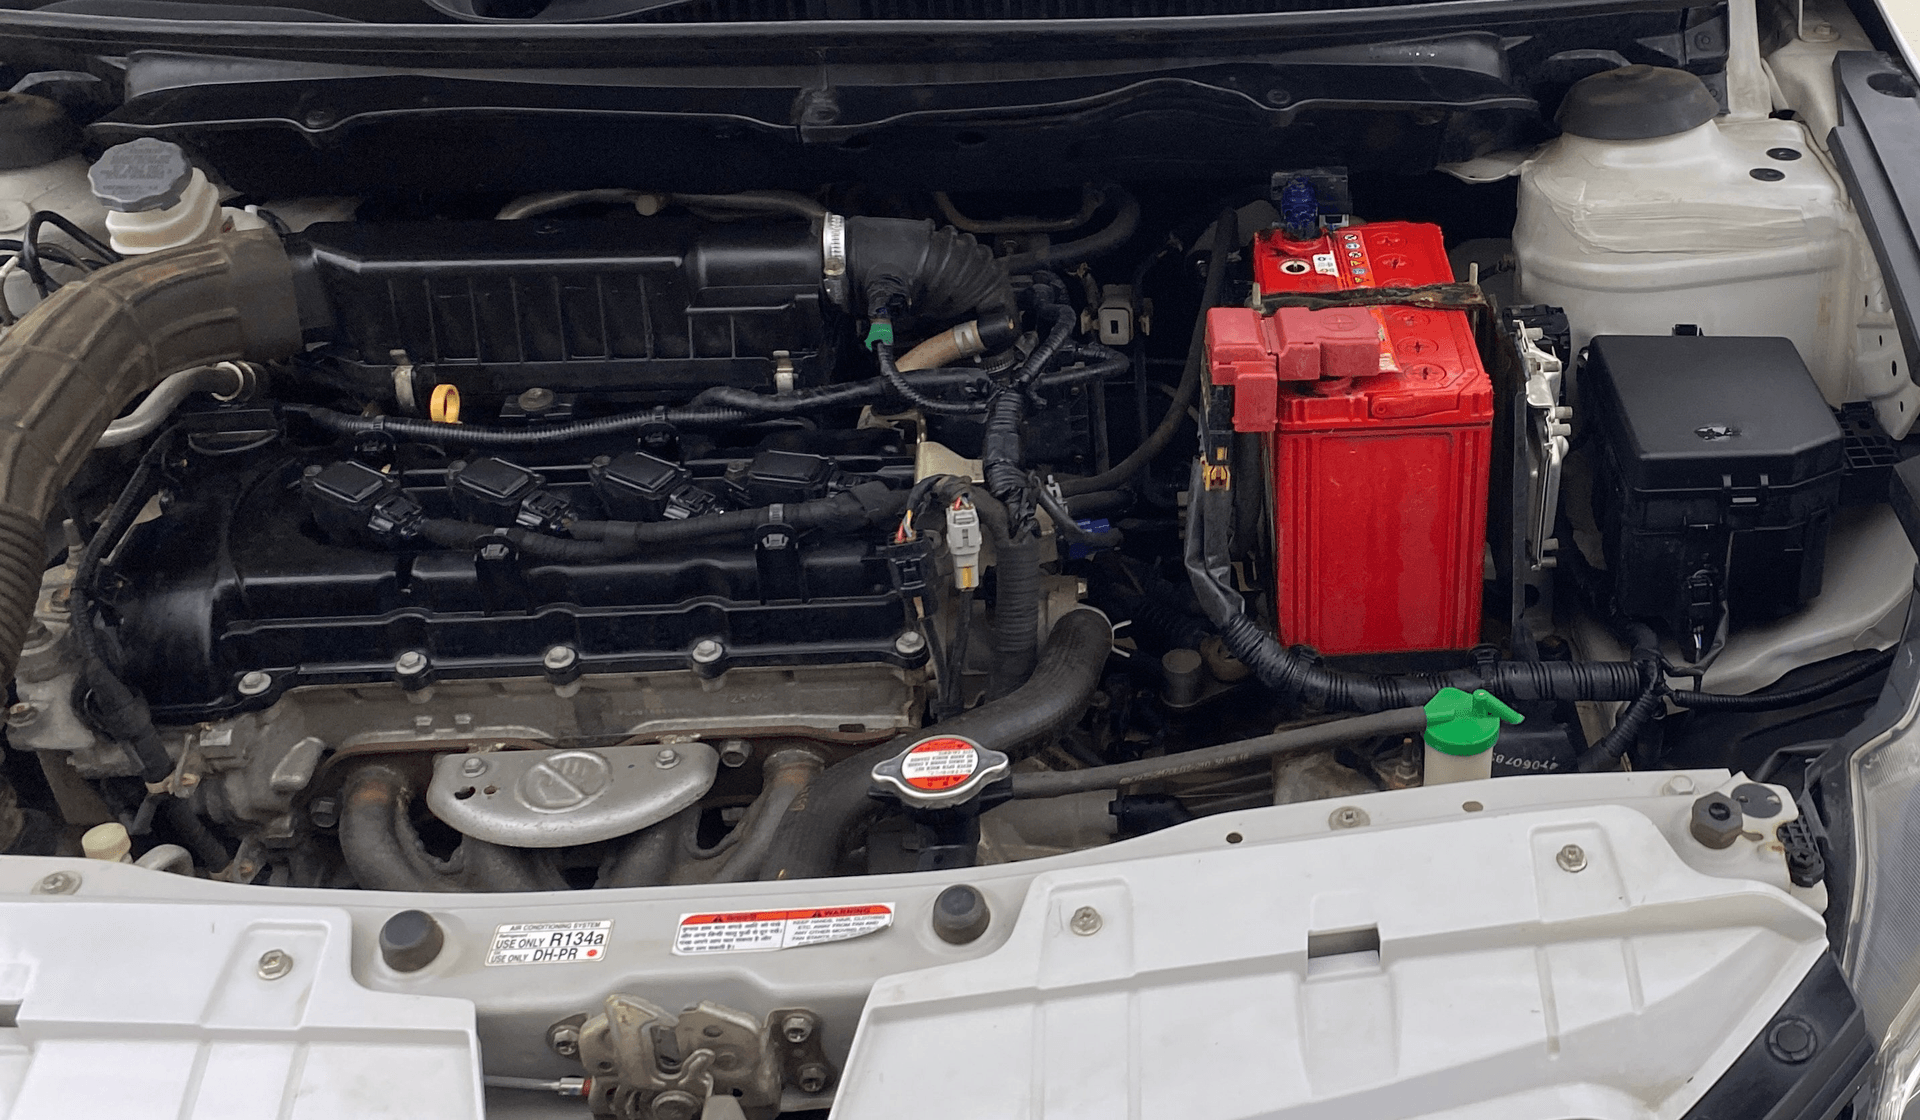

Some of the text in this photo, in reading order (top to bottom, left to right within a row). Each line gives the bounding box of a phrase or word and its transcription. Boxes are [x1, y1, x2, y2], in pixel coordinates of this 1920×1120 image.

[824, 907, 870, 916] WARNING
[496, 931, 605, 949] USE ONLY R134a
[491, 948, 578, 964] USE ONLY DH-PR
